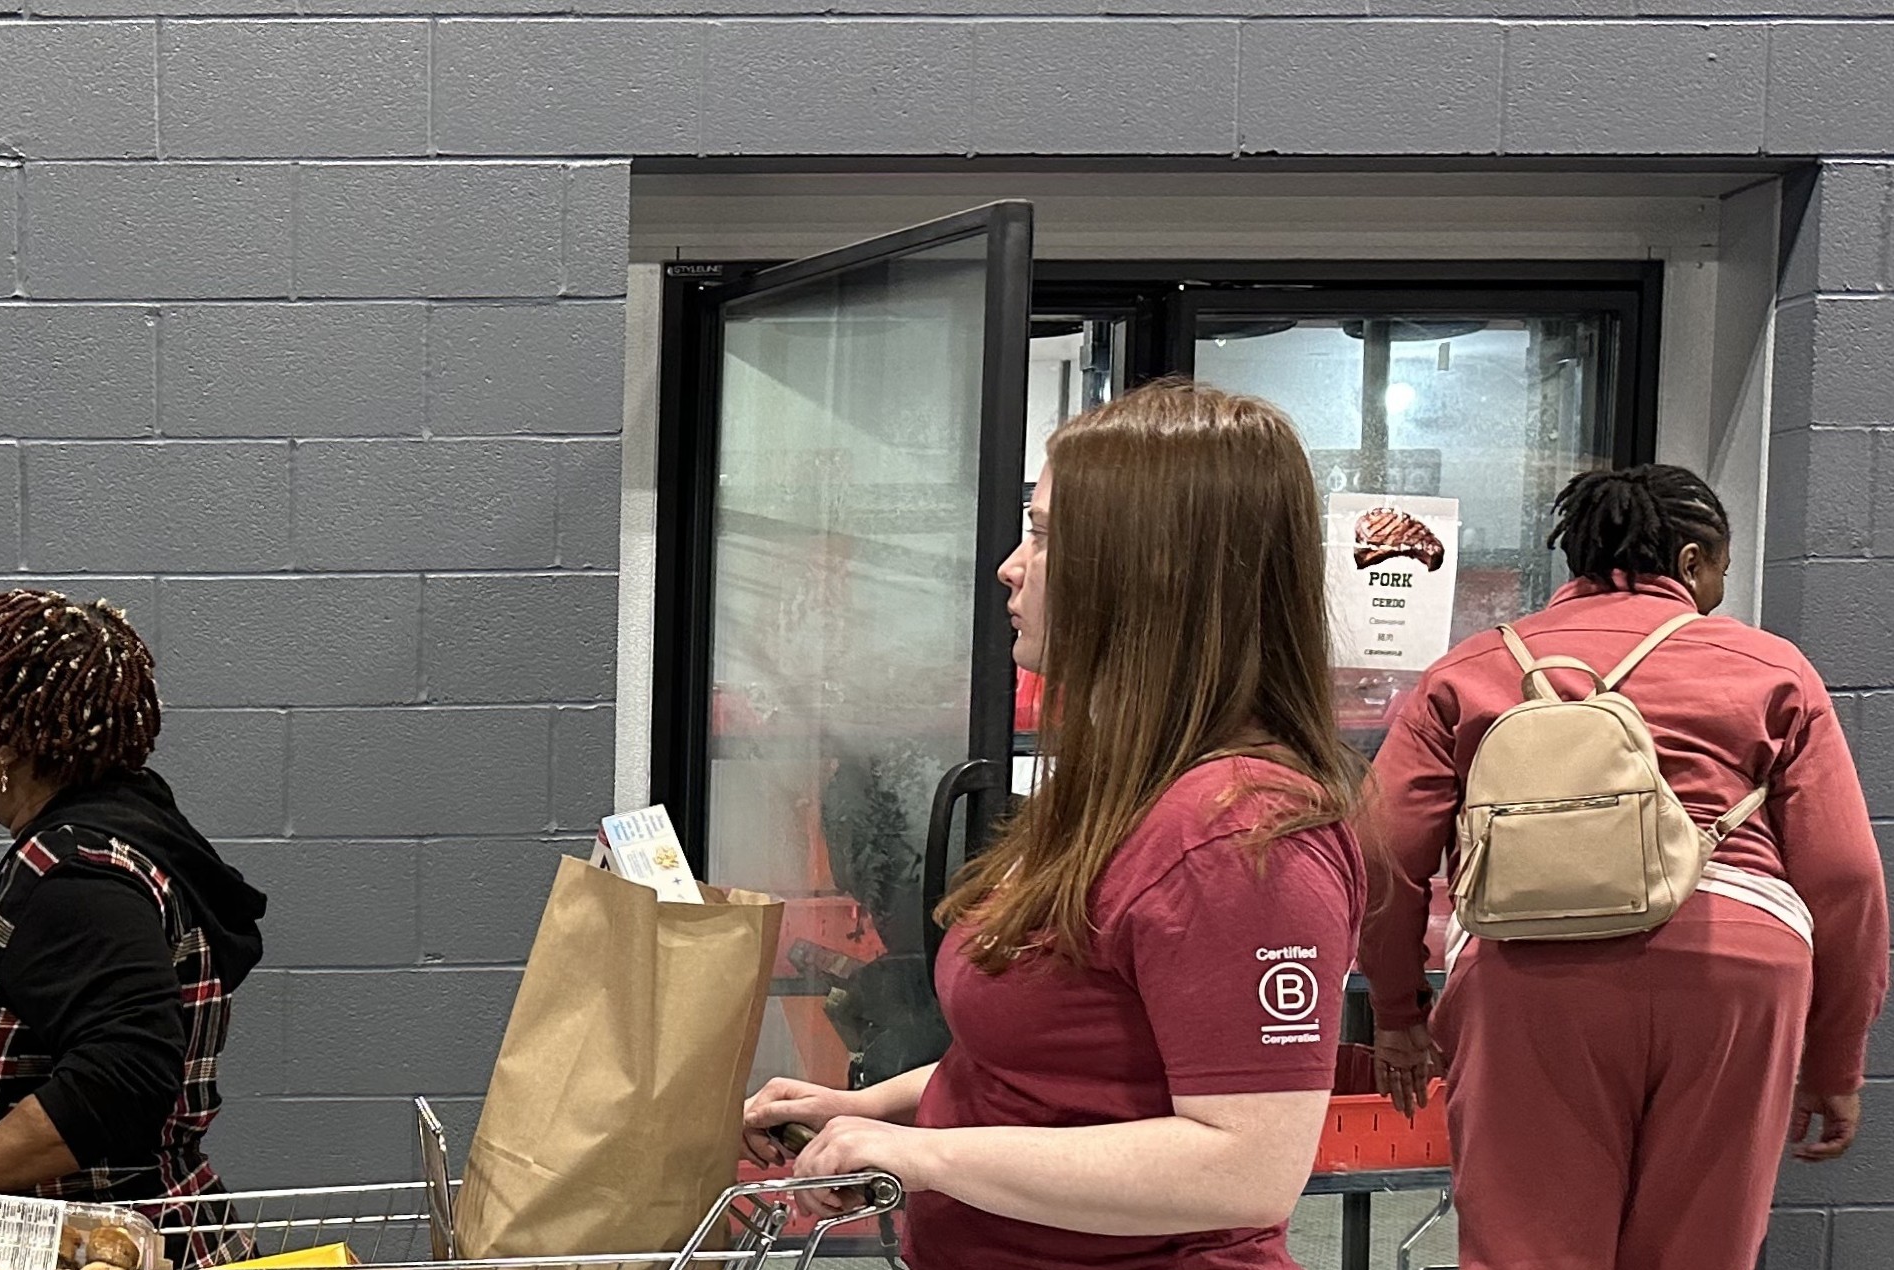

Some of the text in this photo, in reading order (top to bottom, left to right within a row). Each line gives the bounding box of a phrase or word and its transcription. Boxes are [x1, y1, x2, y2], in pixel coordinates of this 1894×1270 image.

[1368, 571, 1413, 588] PORK
[1372, 598, 1406, 608] CERDO
[1256, 946, 1318, 961] Certified
[1276, 973, 1306, 1010] B
[1262, 1033, 1321, 1045] Corporation
